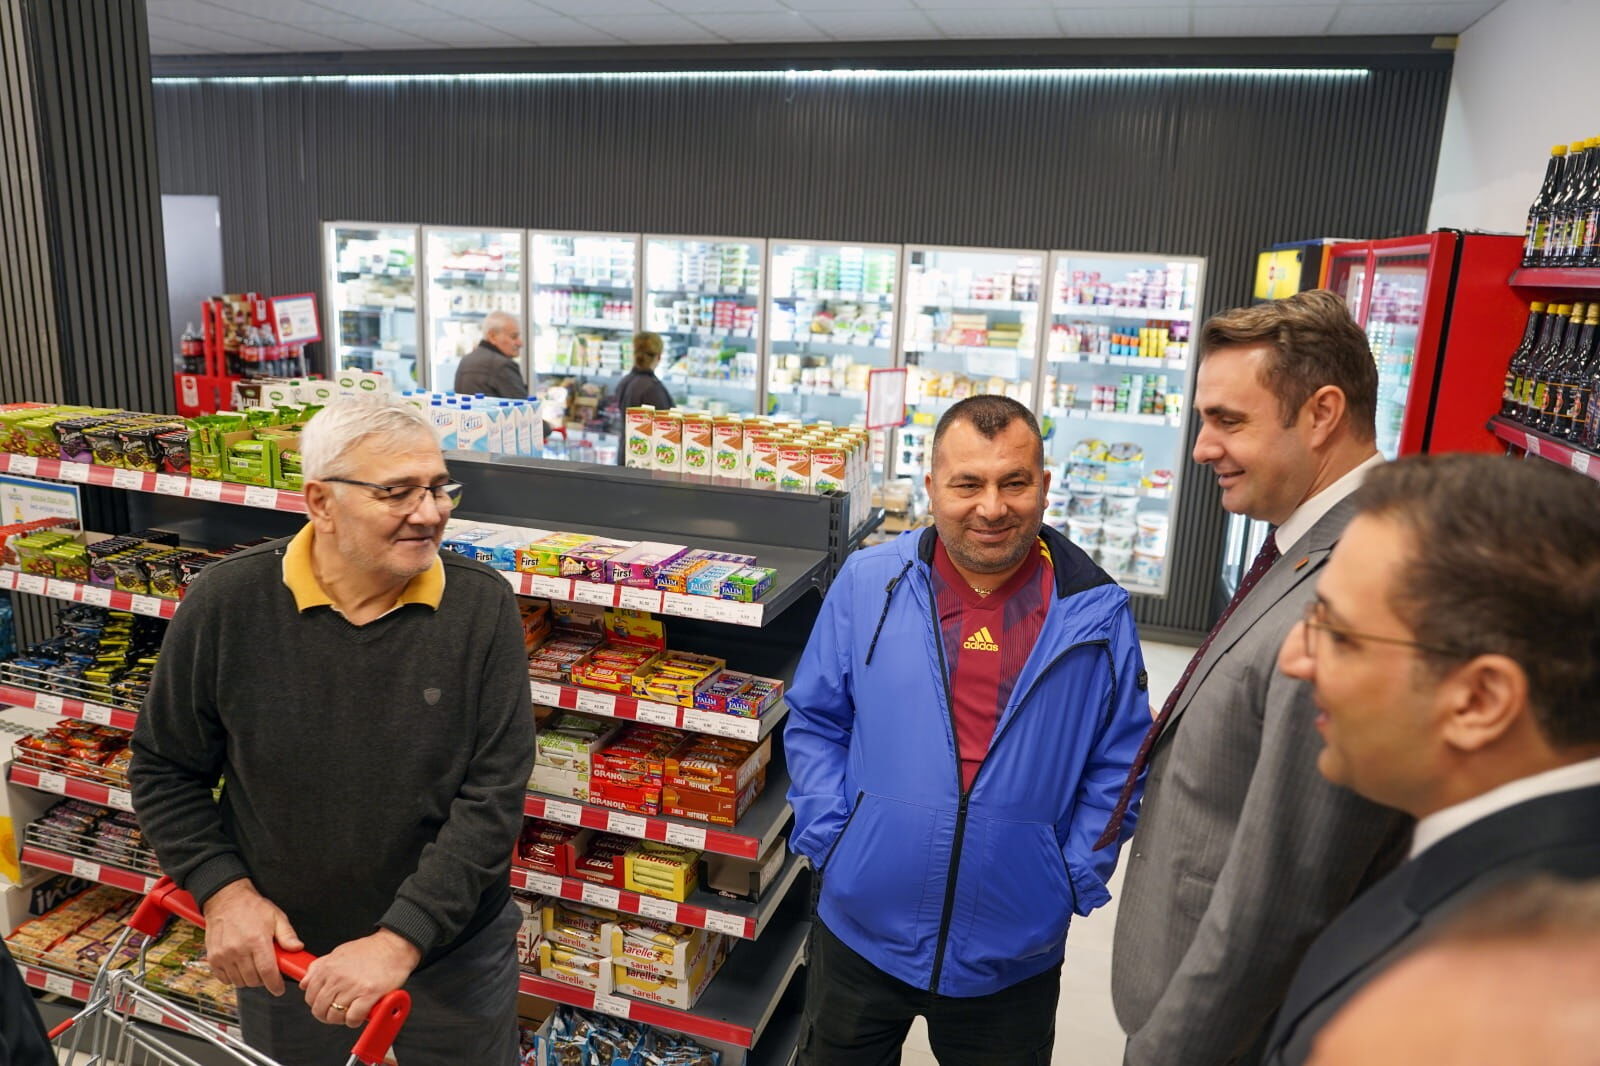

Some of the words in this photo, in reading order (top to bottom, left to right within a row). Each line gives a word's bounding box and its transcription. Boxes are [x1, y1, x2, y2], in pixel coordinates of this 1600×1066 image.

[475, 552, 493, 562] First
[520, 556, 539, 567] First
[612, 567, 632, 578] First
[656, 578, 677, 586] FALIM
[722, 586, 743, 595] FALIM
[963, 640, 999, 652] adidas
[696, 696, 717, 705] FALIM
[728, 701, 749, 710] FALIM
[590, 797, 627, 810] GRANOLA
[558, 936, 586, 949] sarelle
[630, 960, 659, 973] sarelle
[556, 973, 584, 986] sarelle
[632, 988, 662, 1001] sarelle
